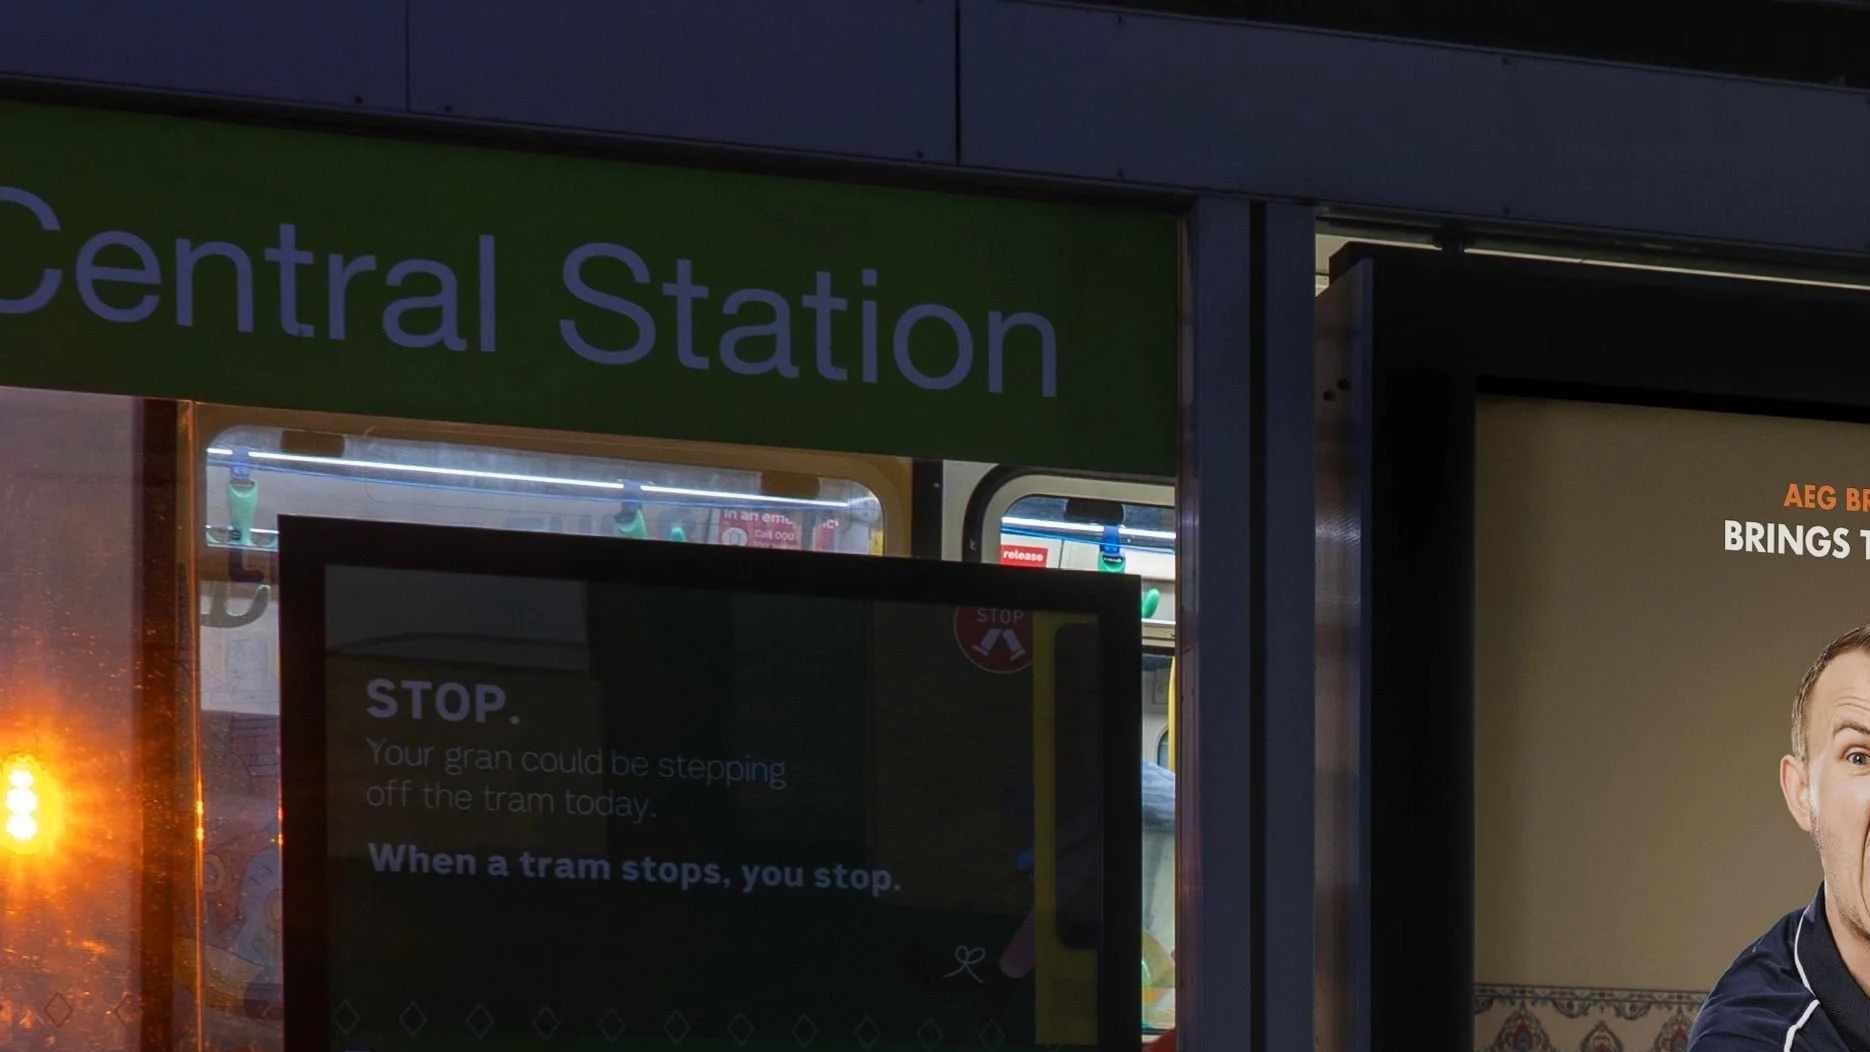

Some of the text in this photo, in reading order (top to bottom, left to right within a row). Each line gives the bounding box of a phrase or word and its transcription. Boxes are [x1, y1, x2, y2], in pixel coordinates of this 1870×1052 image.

[0, 186, 1058, 397] Central Station
[1783, 484, 1837, 510] AEG
[1003, 549, 1044, 561] release
[1725, 520, 1850, 559] BRINGS
[977, 607, 1024, 624] STOP
[366, 678, 521, 725] STOP.
[365, 737, 787, 790] Your gran could be stepping
[365, 778, 657, 824] off the tram today.
[367, 842, 902, 897] When a tram stops, you stop.
